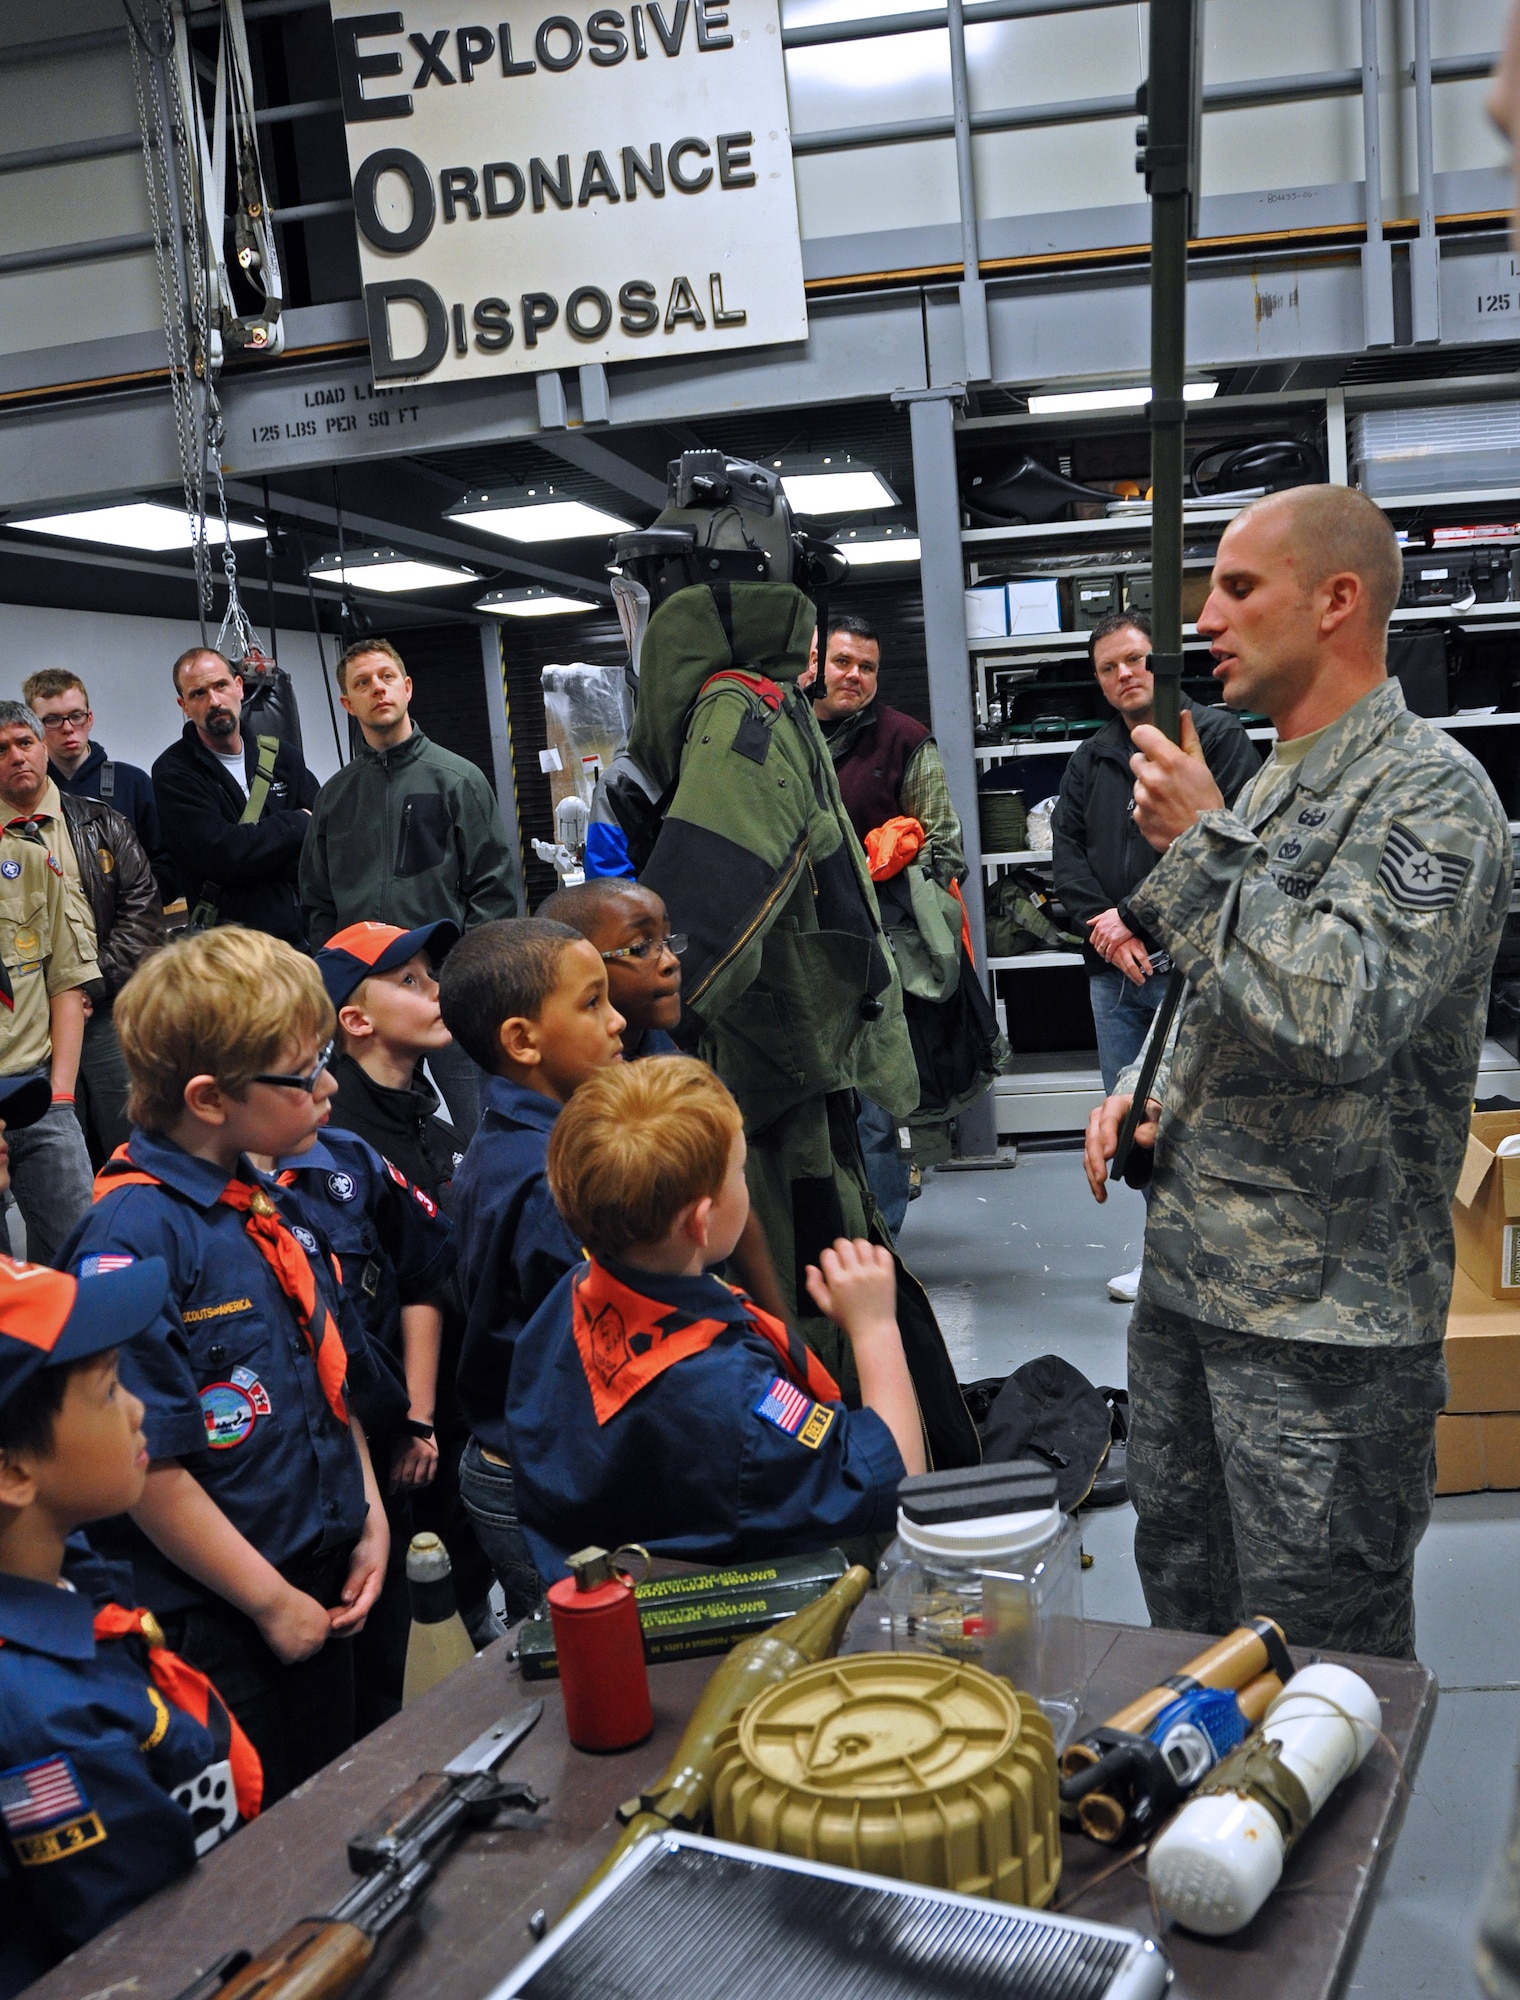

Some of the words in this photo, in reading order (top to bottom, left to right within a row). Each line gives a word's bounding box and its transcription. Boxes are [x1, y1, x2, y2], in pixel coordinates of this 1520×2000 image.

[333, 0, 734, 122] EXPLOSIVE
[353, 130, 757, 252] ORDNANCE
[364, 272, 747, 379] DISPOSAL
[1478, 293, 1510, 313] 125
[252, 425, 280, 442] 125
[286, 420, 317, 439] LBS
[326, 414, 358, 433] PER
[368, 410, 390, 427] SQ
[400, 406, 419, 423] FT
[304, 387, 345, 408] LOAD
